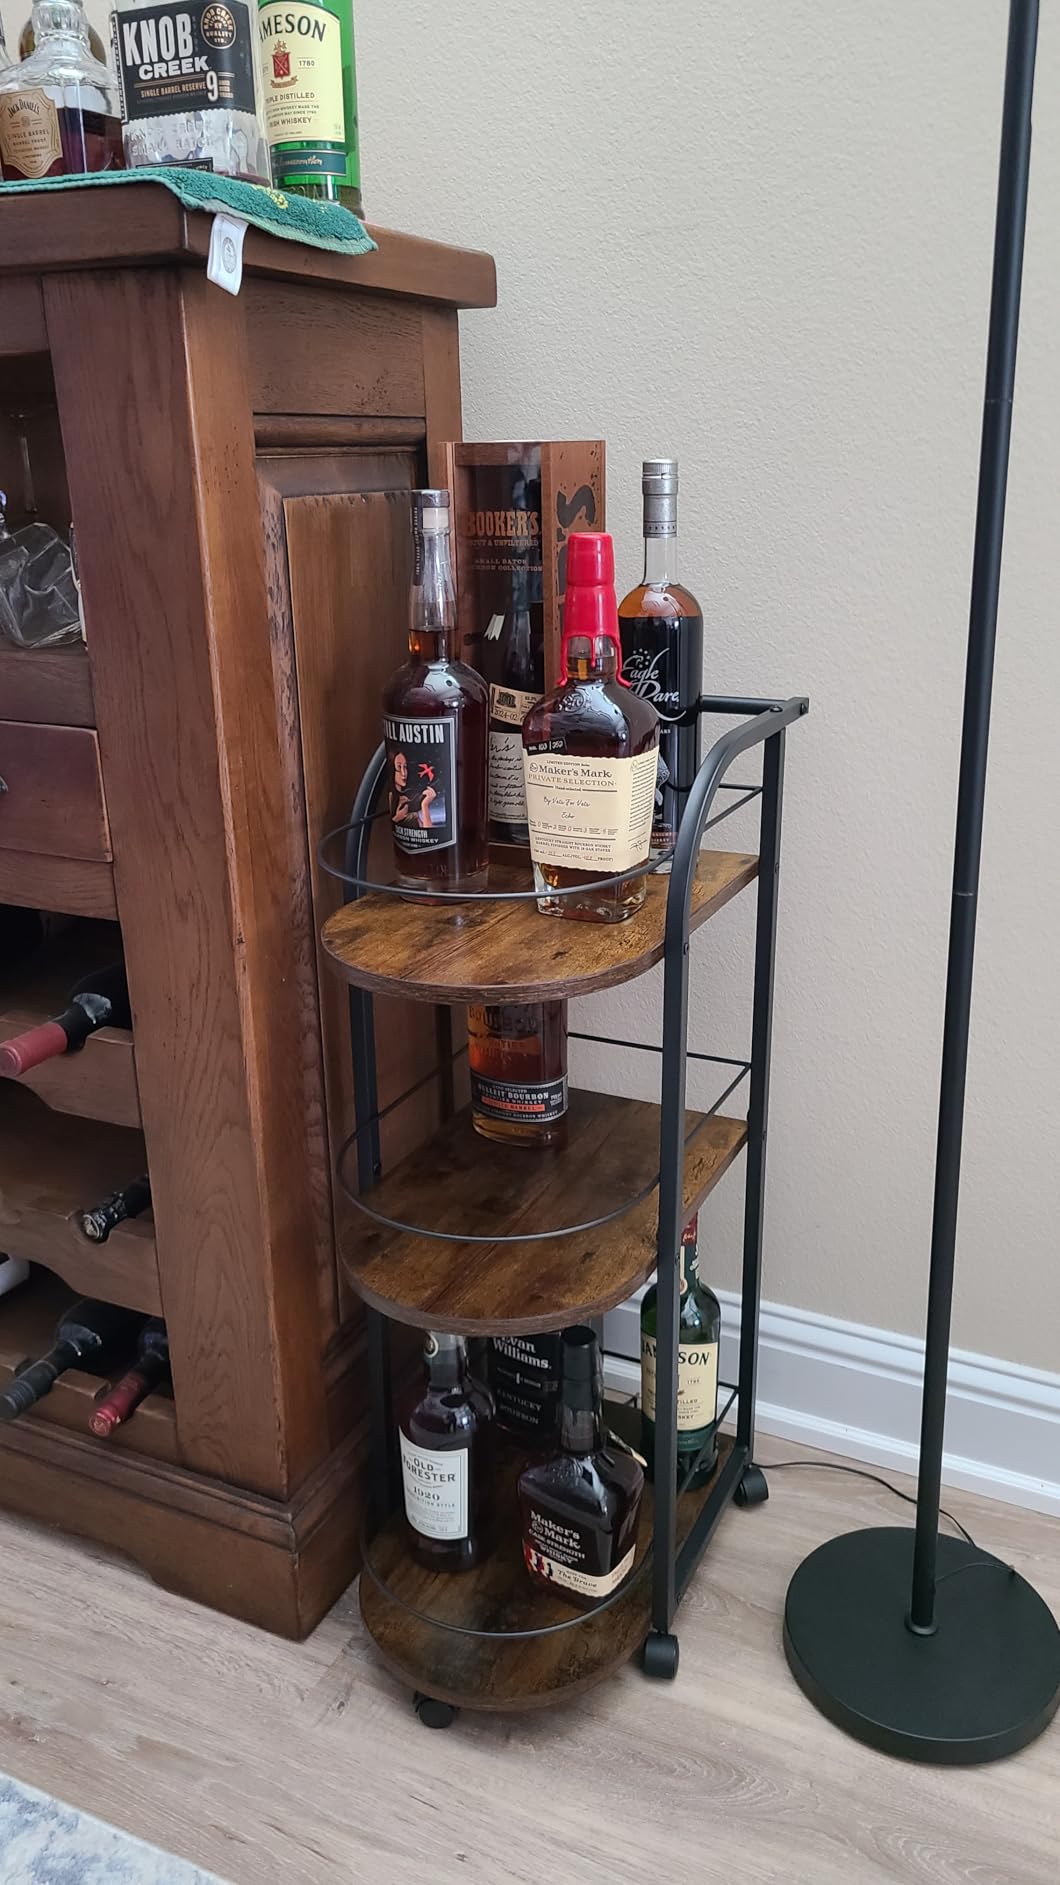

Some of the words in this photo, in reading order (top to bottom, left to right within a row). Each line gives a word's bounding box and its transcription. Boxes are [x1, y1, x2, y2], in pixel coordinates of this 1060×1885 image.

[123, 13, 194, 66] KNOB
[138, 56, 209, 80] CREEK
[141, 86, 160, 98] SINGLE
[160, 83, 181, 95] BARREL
[182, 81, 206, 92] RESERVE
[206, 71, 218, 101] 9
[279, 92, 315, 101] DISTILLED
[280, 116, 312, 125] WHISKEY
[464, 511, 539, 536] BOOKER'S
[399, 723, 444, 744] AUSTIN
[528, 773, 561, 783] PRIVATE
[563, 778, 615, 787] SELECTION
[539, 765, 579, 776] Maker's
[580, 769, 612, 778] Mark
[507, 1092, 549, 1100] BOURBON
[402, 1453, 456, 1482] FORESTER
[413, 1457, 434, 1472] OLD
[412, 1486, 440, 1501] 1920
[530, 1510, 580, 1540] Maker's
[544, 1527, 581, 1549] Mark
[545, 1537, 586, 1559] STRENGTH
